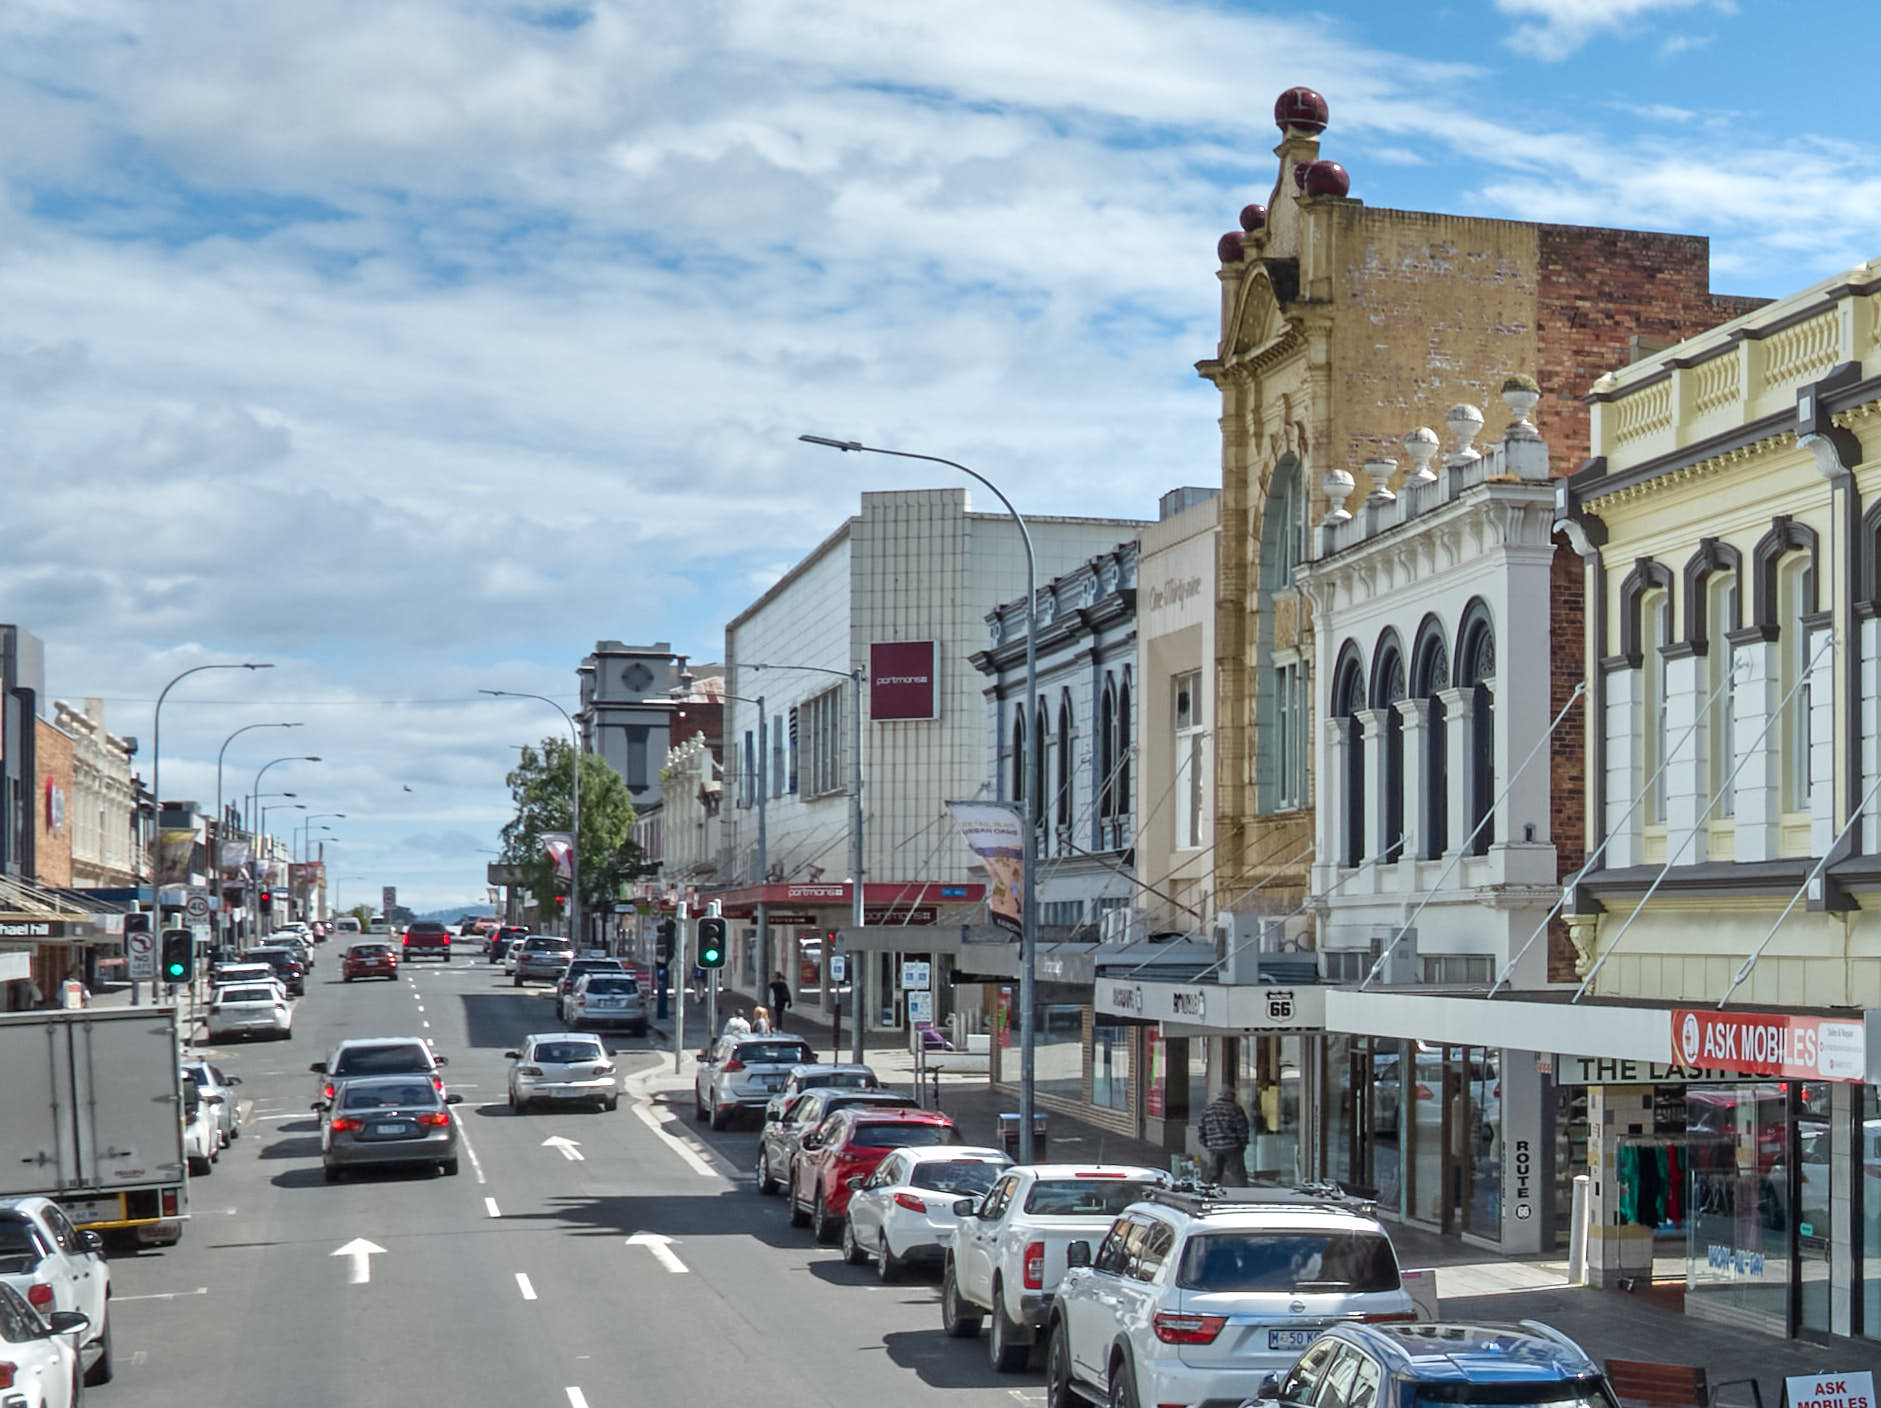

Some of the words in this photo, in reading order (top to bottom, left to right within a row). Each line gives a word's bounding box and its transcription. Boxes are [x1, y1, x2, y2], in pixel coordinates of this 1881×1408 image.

[1270, 1002, 1291, 1017] 66
[1704, 1022, 1737, 1060] ASK
[1741, 1025, 1817, 1068] MOBILES
[1577, 1058, 1637, 1082] THE
[1516, 1140, 1530, 1198] ROUTE
[1815, 1380, 1848, 1396] ASK
